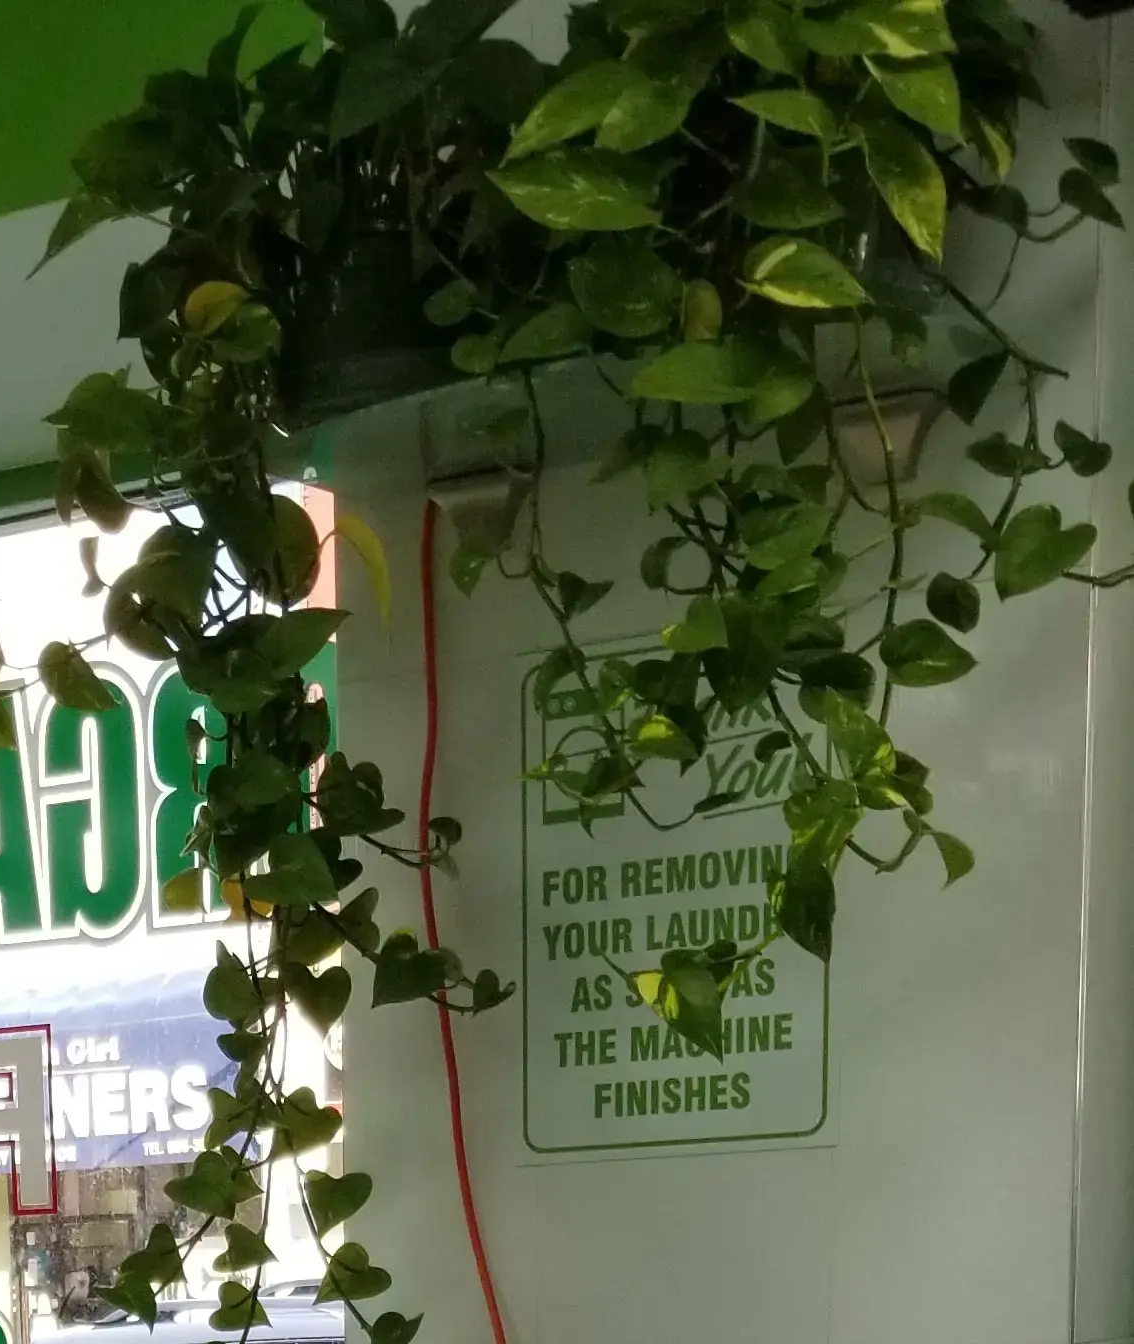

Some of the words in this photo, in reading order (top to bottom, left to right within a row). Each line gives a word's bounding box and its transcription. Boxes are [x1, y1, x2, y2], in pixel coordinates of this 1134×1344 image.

[542, 866, 607, 907] FOR
[620, 843, 793, 899] REMOVIN
[542, 918, 633, 961] YOUR
[646, 903, 787, 952] LAUNDR
[571, 973, 613, 1013] AS
[730, 958, 776, 998] AS
[554, 1028, 617, 1068] THE
[594, 1072, 752, 1119] FINISHES
